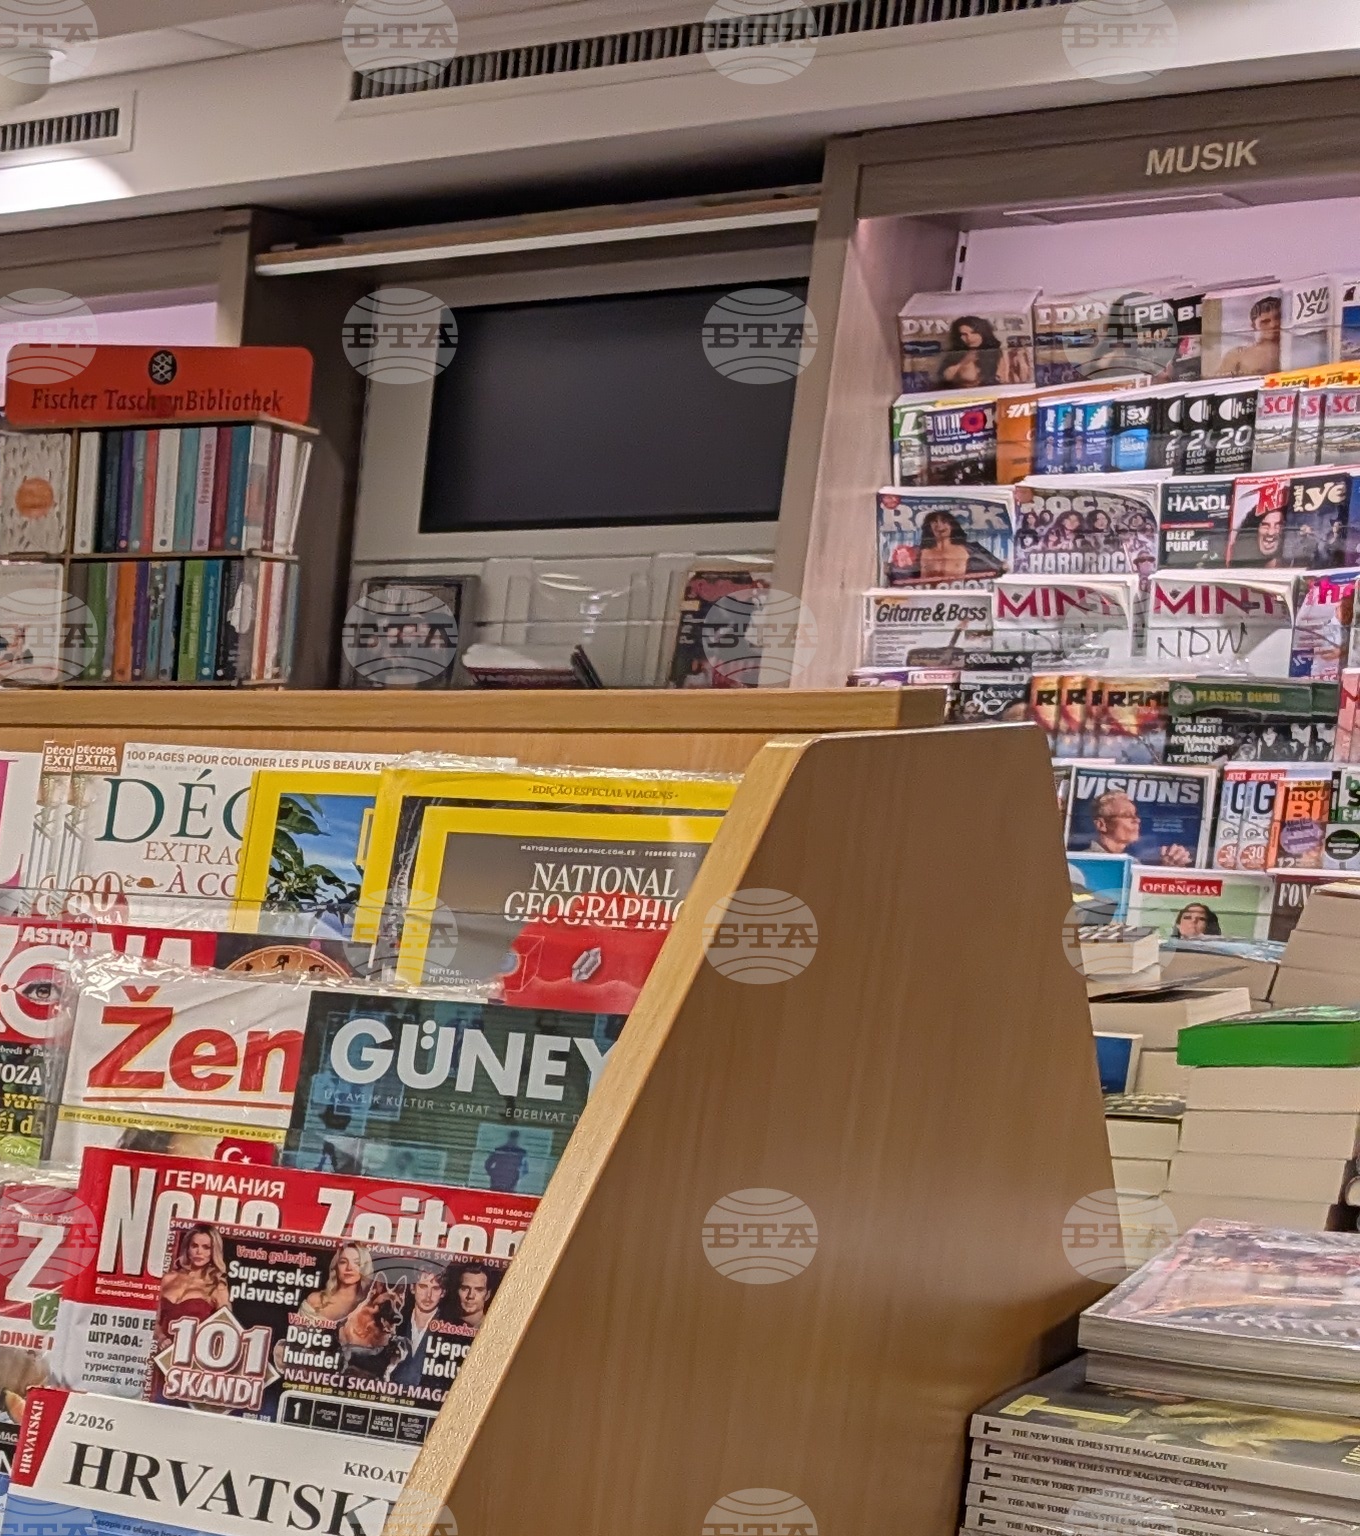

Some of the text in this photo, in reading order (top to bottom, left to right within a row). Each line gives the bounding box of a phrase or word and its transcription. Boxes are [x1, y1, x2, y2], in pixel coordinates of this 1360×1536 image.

[1146, 140, 1258, 175] MUSIK
[32, 388, 283, 413] Fischer TaschnBibliothek
[1166, 539, 1209, 553] PURPLE
[76, 755, 116, 768] EXTRA
[126, 749, 371, 772] 100 PAGES POUR COLORIER LES PLUS BEAUX
[1076, 775, 1199, 803] VISIONS
[533, 862, 679, 898] NATIONAL
[21, 927, 88, 947] ASTRO
[450, 1102, 489, 1115] SANAT
[164, 1169, 285, 1199] ГЕРМАНИЯ
[228, 1260, 321, 1289] Superseksi
[230, 1283, 300, 1307] plavuše!
[114, 1315, 145, 1330] 1500
[88, 1329, 143, 1349] ШТРАФА:
[168, 1314, 272, 1376] 101
[286, 1324, 332, 1349] Dojče
[283, 1345, 340, 1371] hunde!
[164, 1368, 263, 1412] SKANDI
[284, 1369, 344, 1393] NAJVEĆI
[66, 1411, 114, 1432] 2/2026
[20, 1400, 45, 1475] HRVATSKI!
